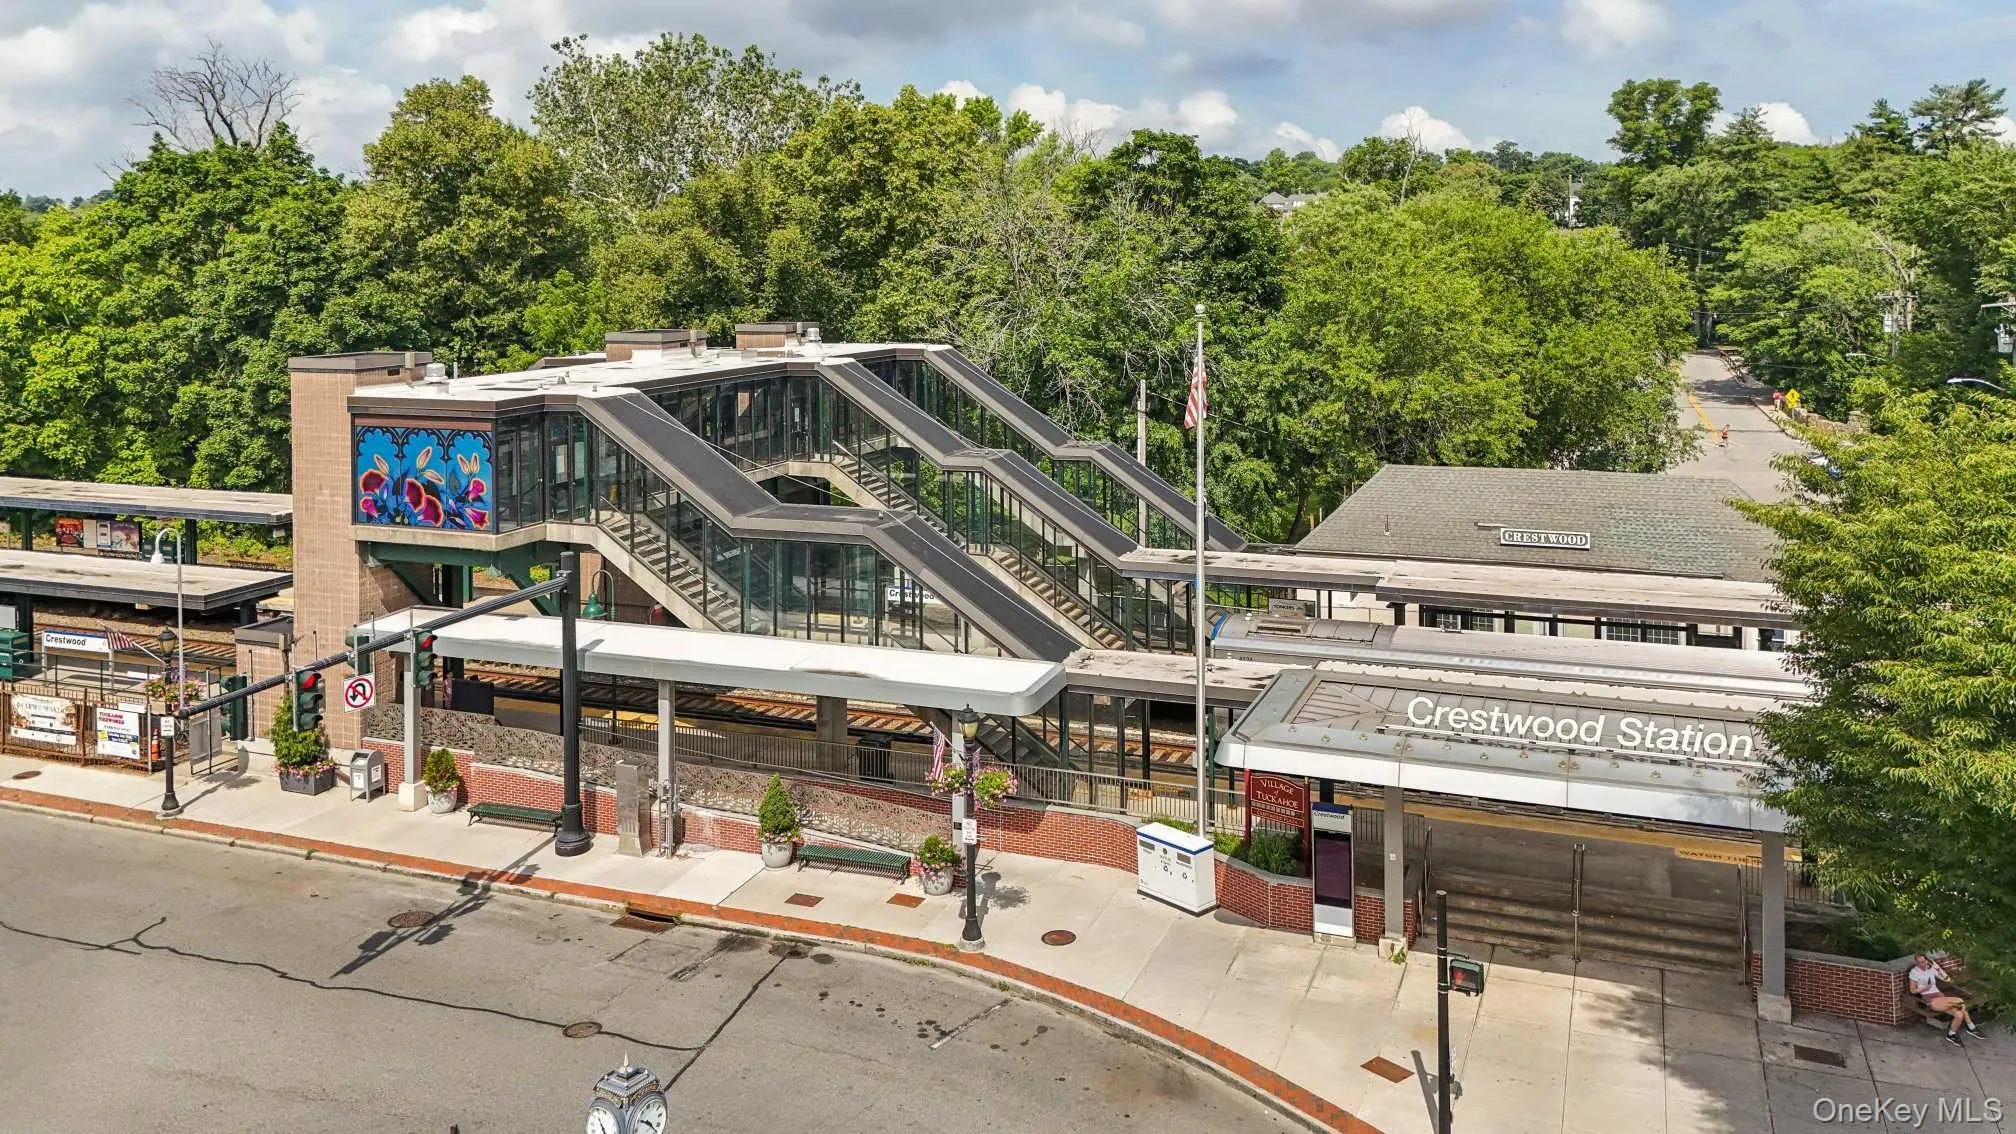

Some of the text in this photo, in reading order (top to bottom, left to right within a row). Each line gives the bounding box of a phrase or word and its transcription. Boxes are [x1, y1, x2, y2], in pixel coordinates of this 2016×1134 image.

[1504, 531, 1587, 547] CRESTWOOD
[45, 634, 87, 646] Crestwood
[1406, 695, 1754, 758] Crestwood Station
[1260, 778, 1294, 795] VILLAGE
[1256, 790, 1299, 809] TUCKAHOE
[1314, 810, 1345, 820] Crestwood
